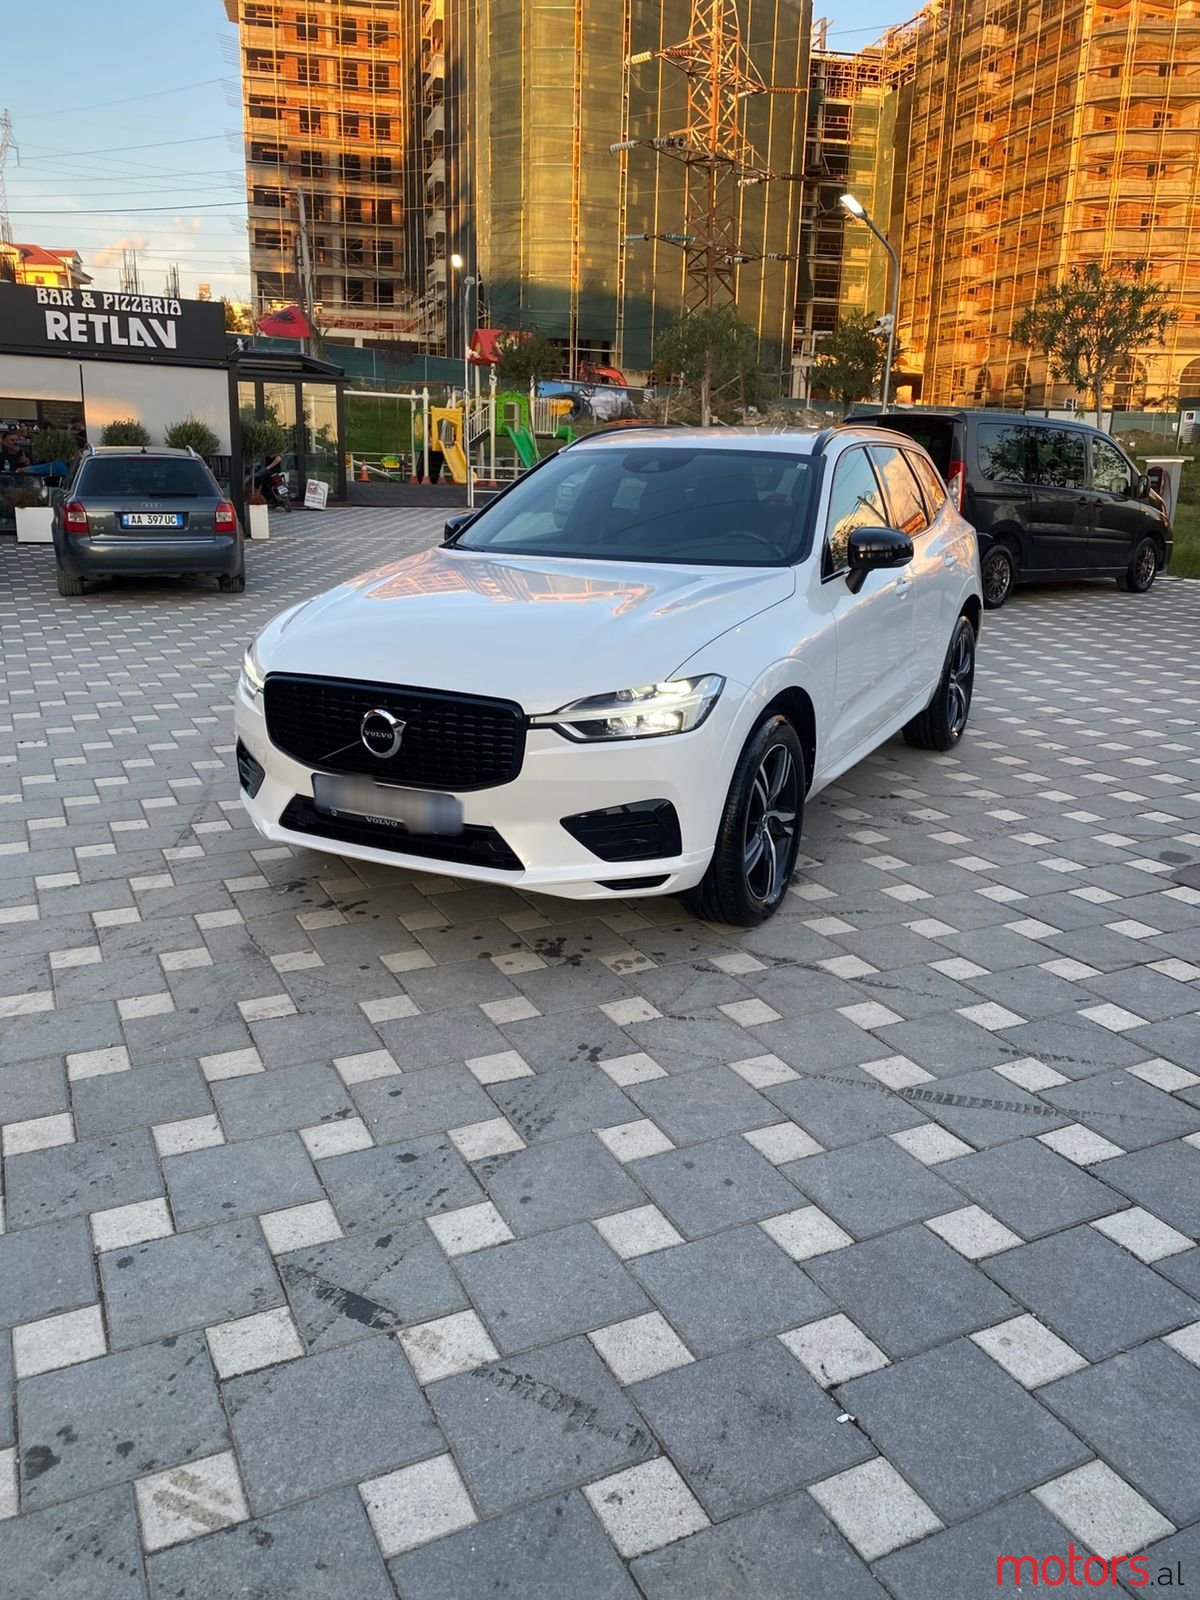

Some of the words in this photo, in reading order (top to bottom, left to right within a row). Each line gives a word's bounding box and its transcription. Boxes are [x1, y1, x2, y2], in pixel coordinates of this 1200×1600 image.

[36, 287, 74, 306] BAR
[82, 292, 96, 308] &
[103, 294, 182, 315] PIZZERIA
[131, 514, 142, 525] AA
[364, 730, 393, 739] VOLVO
[365, 816, 398, 827] VOLVO
